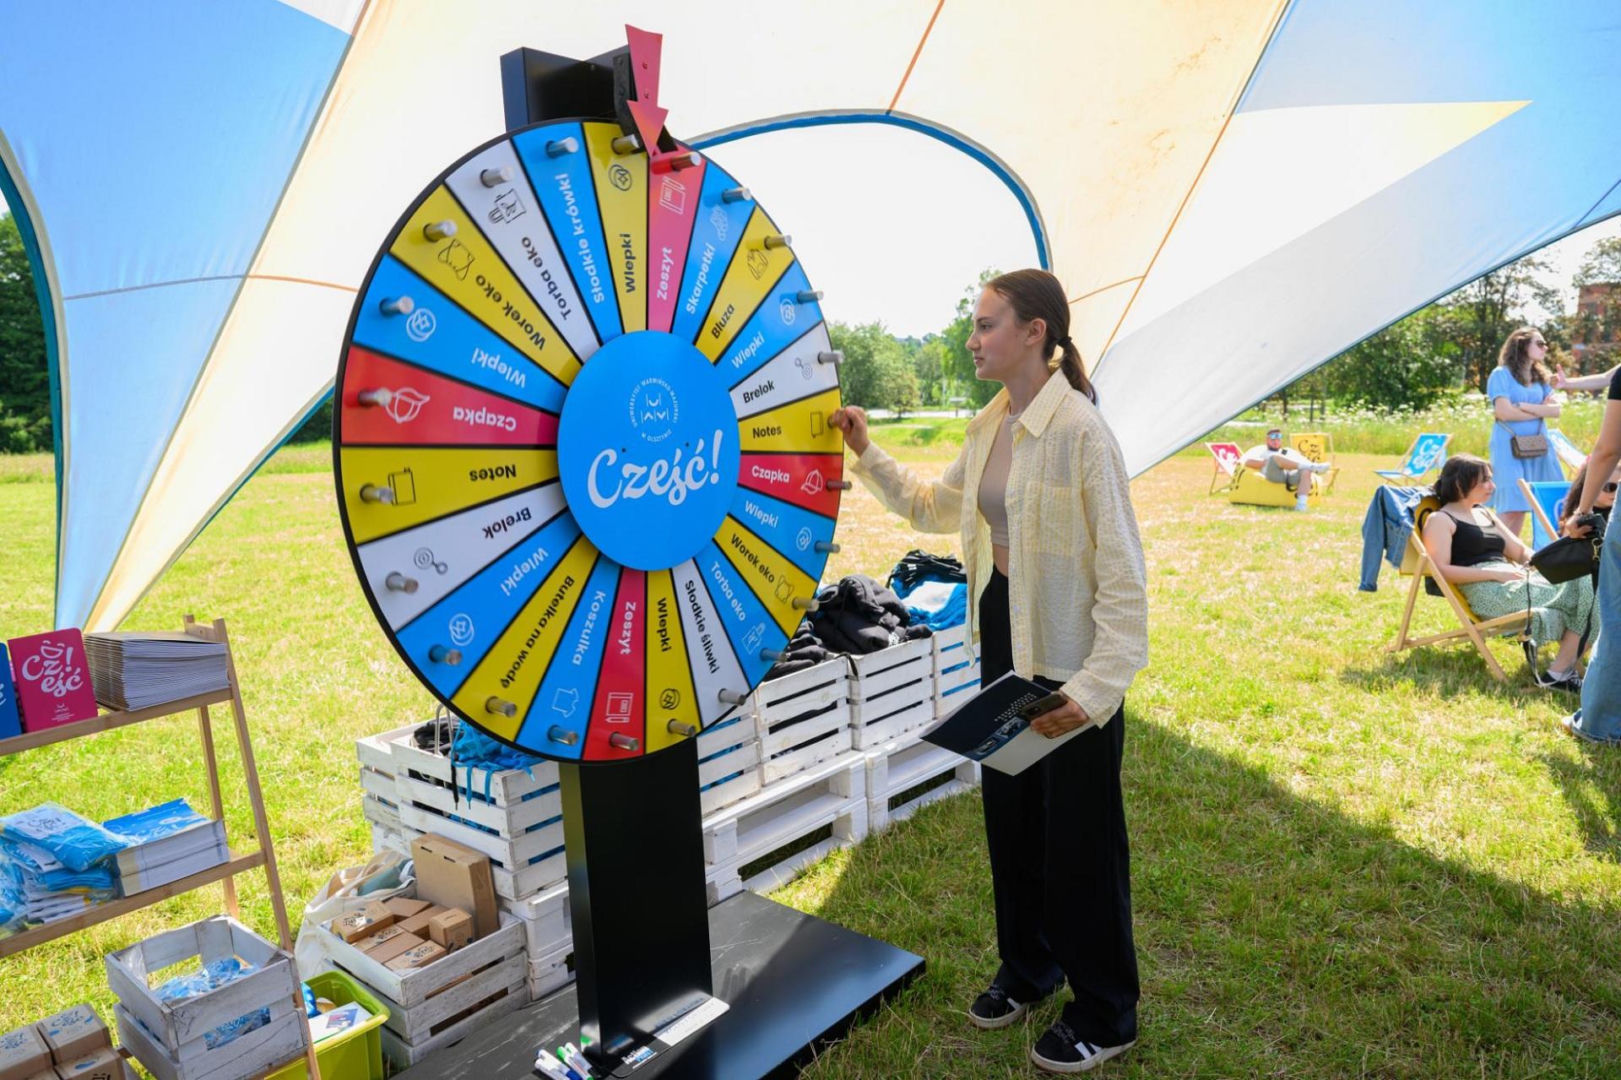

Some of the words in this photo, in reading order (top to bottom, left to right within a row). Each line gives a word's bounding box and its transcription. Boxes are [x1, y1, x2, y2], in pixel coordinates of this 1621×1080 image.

[554, 173, 585, 236] krówki
[521, 236, 543, 268] eko
[619, 233, 636, 293] Wlepki
[657, 247, 674, 300] Zeszyt
[475, 273, 503, 302] eko
[541, 268, 571, 321] Torba
[686, 243, 716, 314] Skarpetki
[504, 300, 547, 351] Worek
[711, 303, 735, 340] Bluza
[471, 347, 527, 389] Wlepki
[731, 332, 765, 369] Wlepki
[742, 380, 775, 404] Brelok
[453, 405, 517, 431] Czapka
[752, 424, 782, 440] Notes
[468, 464, 517, 483] Notes
[587, 429, 723, 509] Cześć!
[751, 464, 790, 483] Czapka
[482, 507, 533, 540] Brelok
[744, 500, 779, 528] Wlepki
[500, 547, 549, 597] Wlepki
[730, 532, 761, 569] Worek
[757, 561, 776, 584] eko
[537, 575, 575, 628] Butelka
[710, 561, 734, 601] Torba
[730, 597, 747, 622] eko
[525, 628, 541, 649] na
[572, 590, 606, 666] Koszulka
[620, 601, 636, 655] Zeszyt
[657, 597, 672, 652] Wlepki
[685, 579, 706, 634] Słodkie
[701, 633, 720, 674] śliwki
[500, 649, 529, 688] wodę
